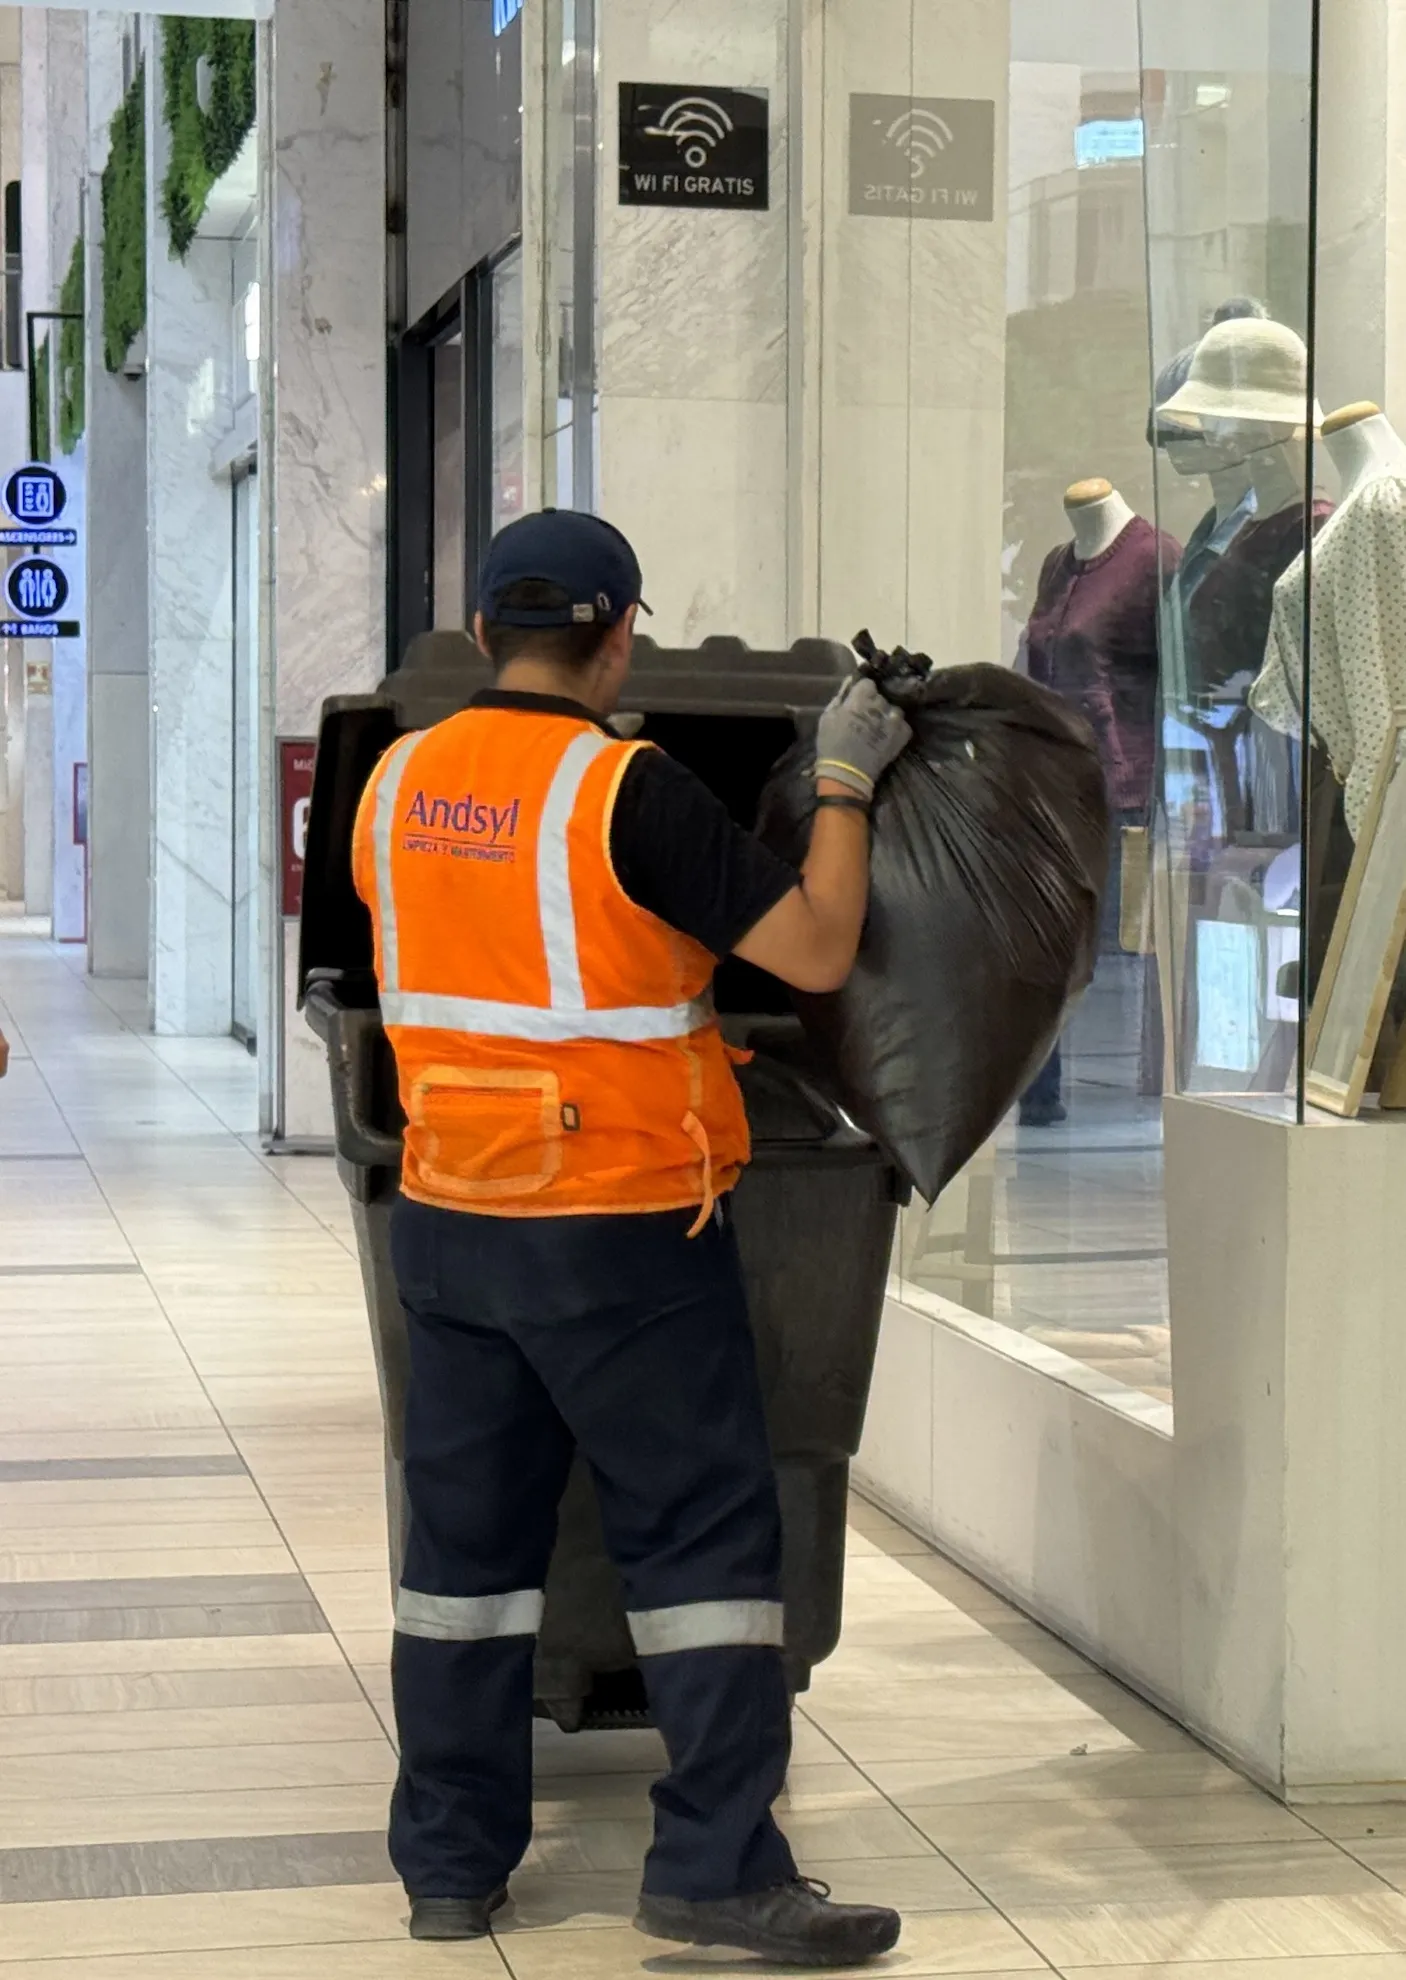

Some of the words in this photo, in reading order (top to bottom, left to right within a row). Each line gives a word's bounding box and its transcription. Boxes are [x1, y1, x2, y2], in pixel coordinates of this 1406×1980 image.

[634, 173, 657, 192] WI
[662, 174, 679, 193] FI
[684, 175, 755, 196] GRATIS
[404, 789, 521, 844] Andsyl
